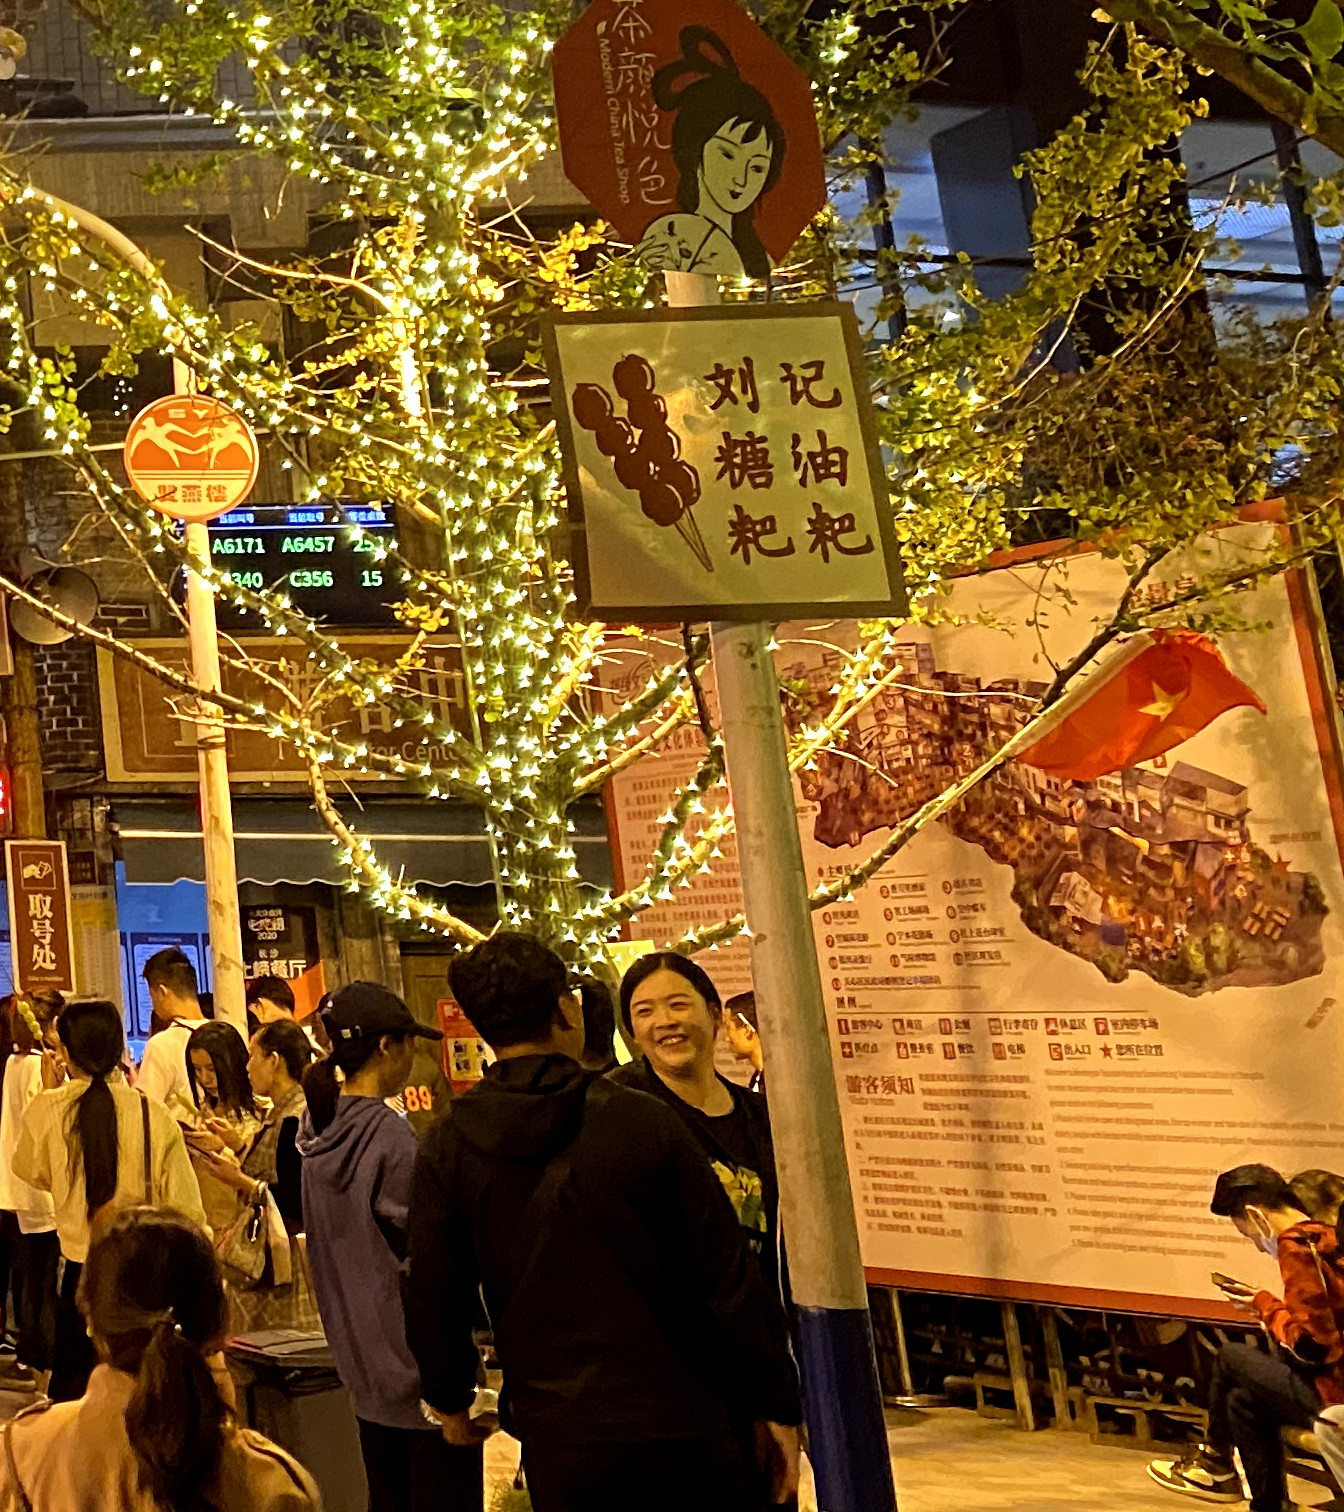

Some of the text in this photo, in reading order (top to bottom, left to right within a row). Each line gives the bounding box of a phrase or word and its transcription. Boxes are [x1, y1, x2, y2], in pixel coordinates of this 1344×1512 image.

[598, 37, 631, 205] Modern China Tea Shop
[703, 356, 844, 414] 刘记
[714, 429, 849, 490] 糖油
[212, 537, 265, 554] A6171
[281, 535, 335, 553] A6457
[727, 501, 875, 566] 粑粑
[227, 570, 383, 589] 340 C356 15
[28, 892, 58, 972] 取号处
[257, 931, 278, 941] 2020
[405, 1085, 433, 1112] 89
